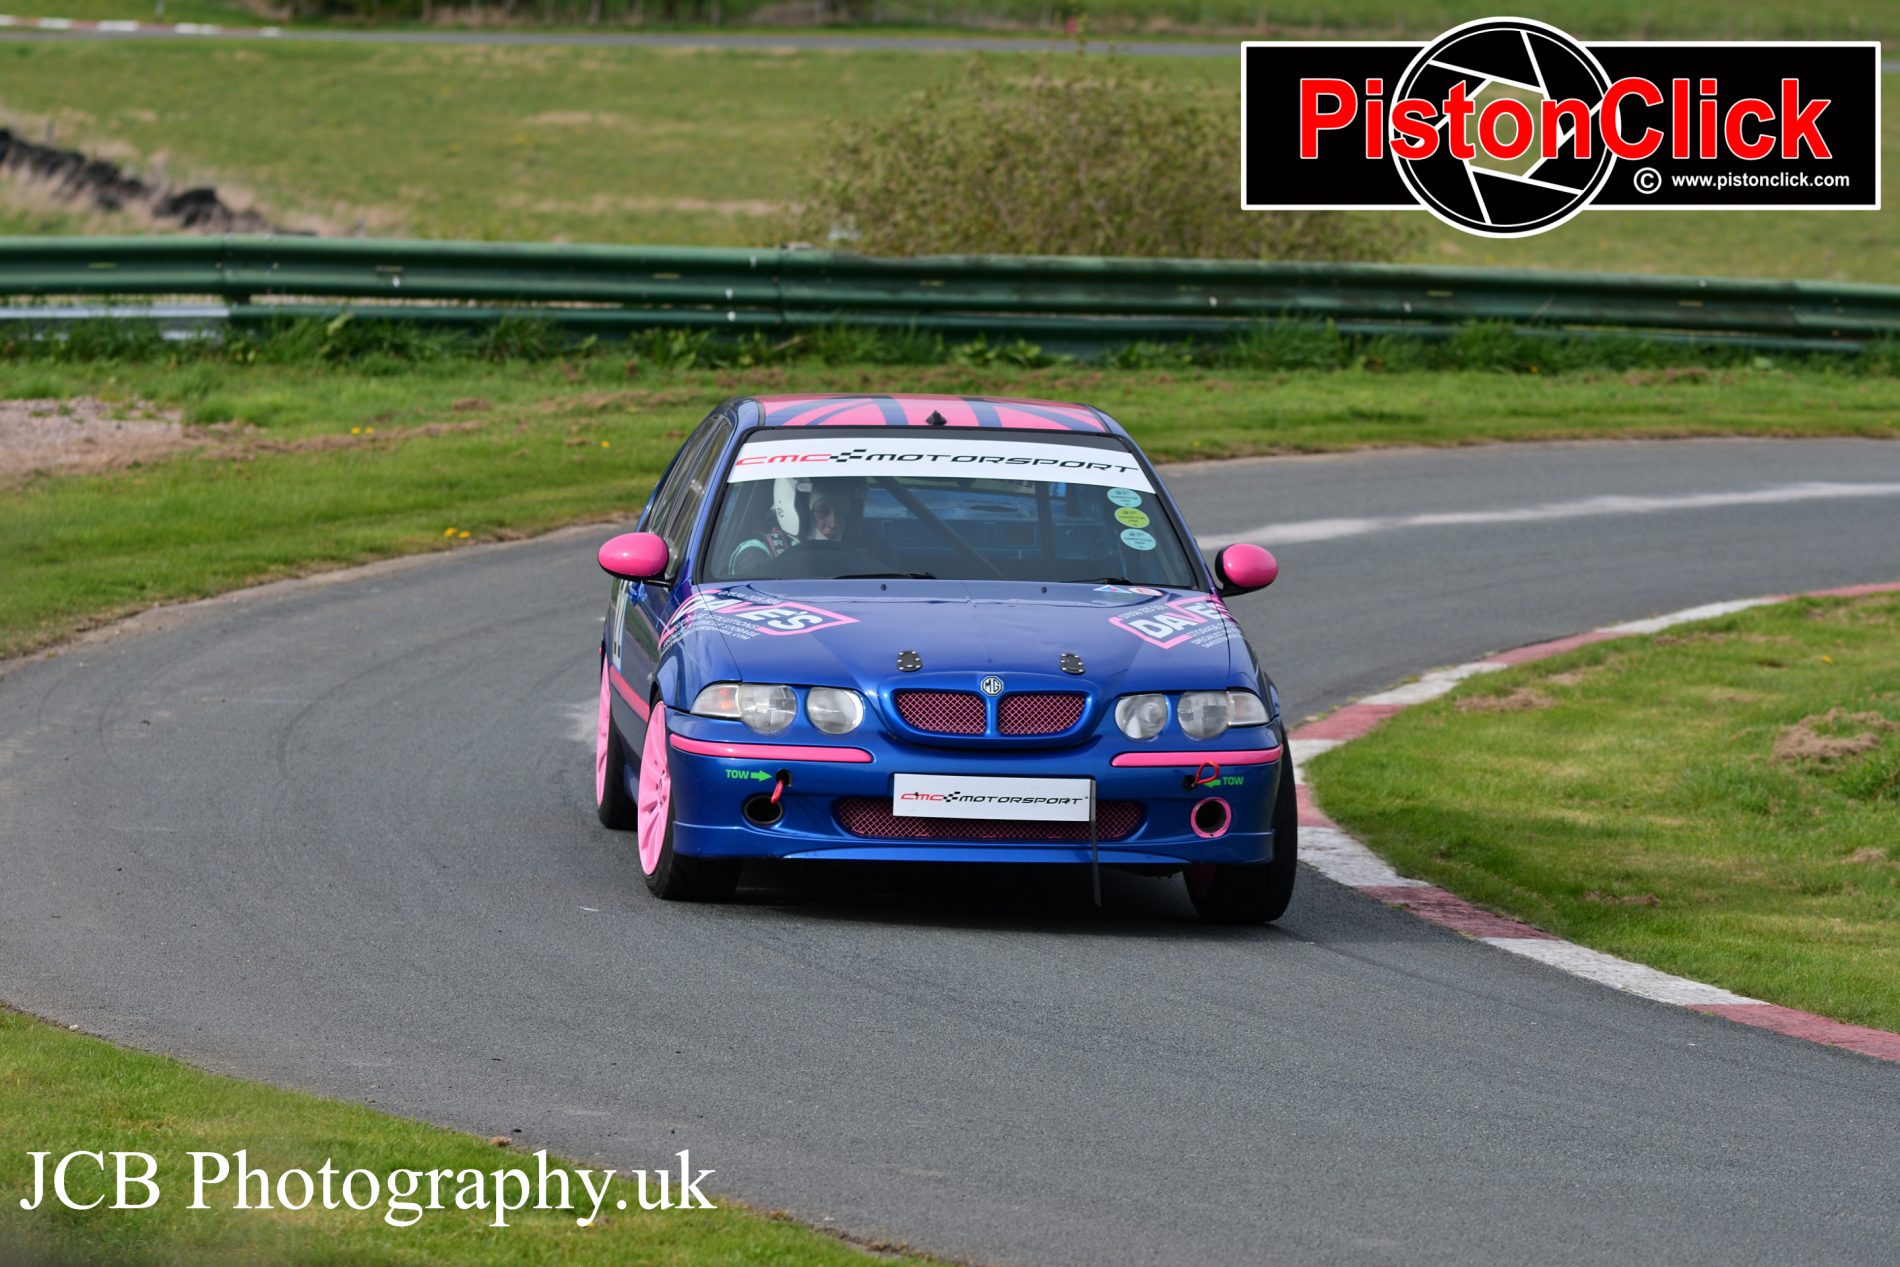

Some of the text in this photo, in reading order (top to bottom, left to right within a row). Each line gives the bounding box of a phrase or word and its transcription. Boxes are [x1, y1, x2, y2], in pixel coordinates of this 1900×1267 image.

[864, 453, 1139, 473] MOTORSPORT
[983, 678, 1002, 694] MG
[726, 768, 749, 779] TOW
[1222, 775, 1244, 785] TOW
[959, 794, 1083, 805] MOTORSPORT
